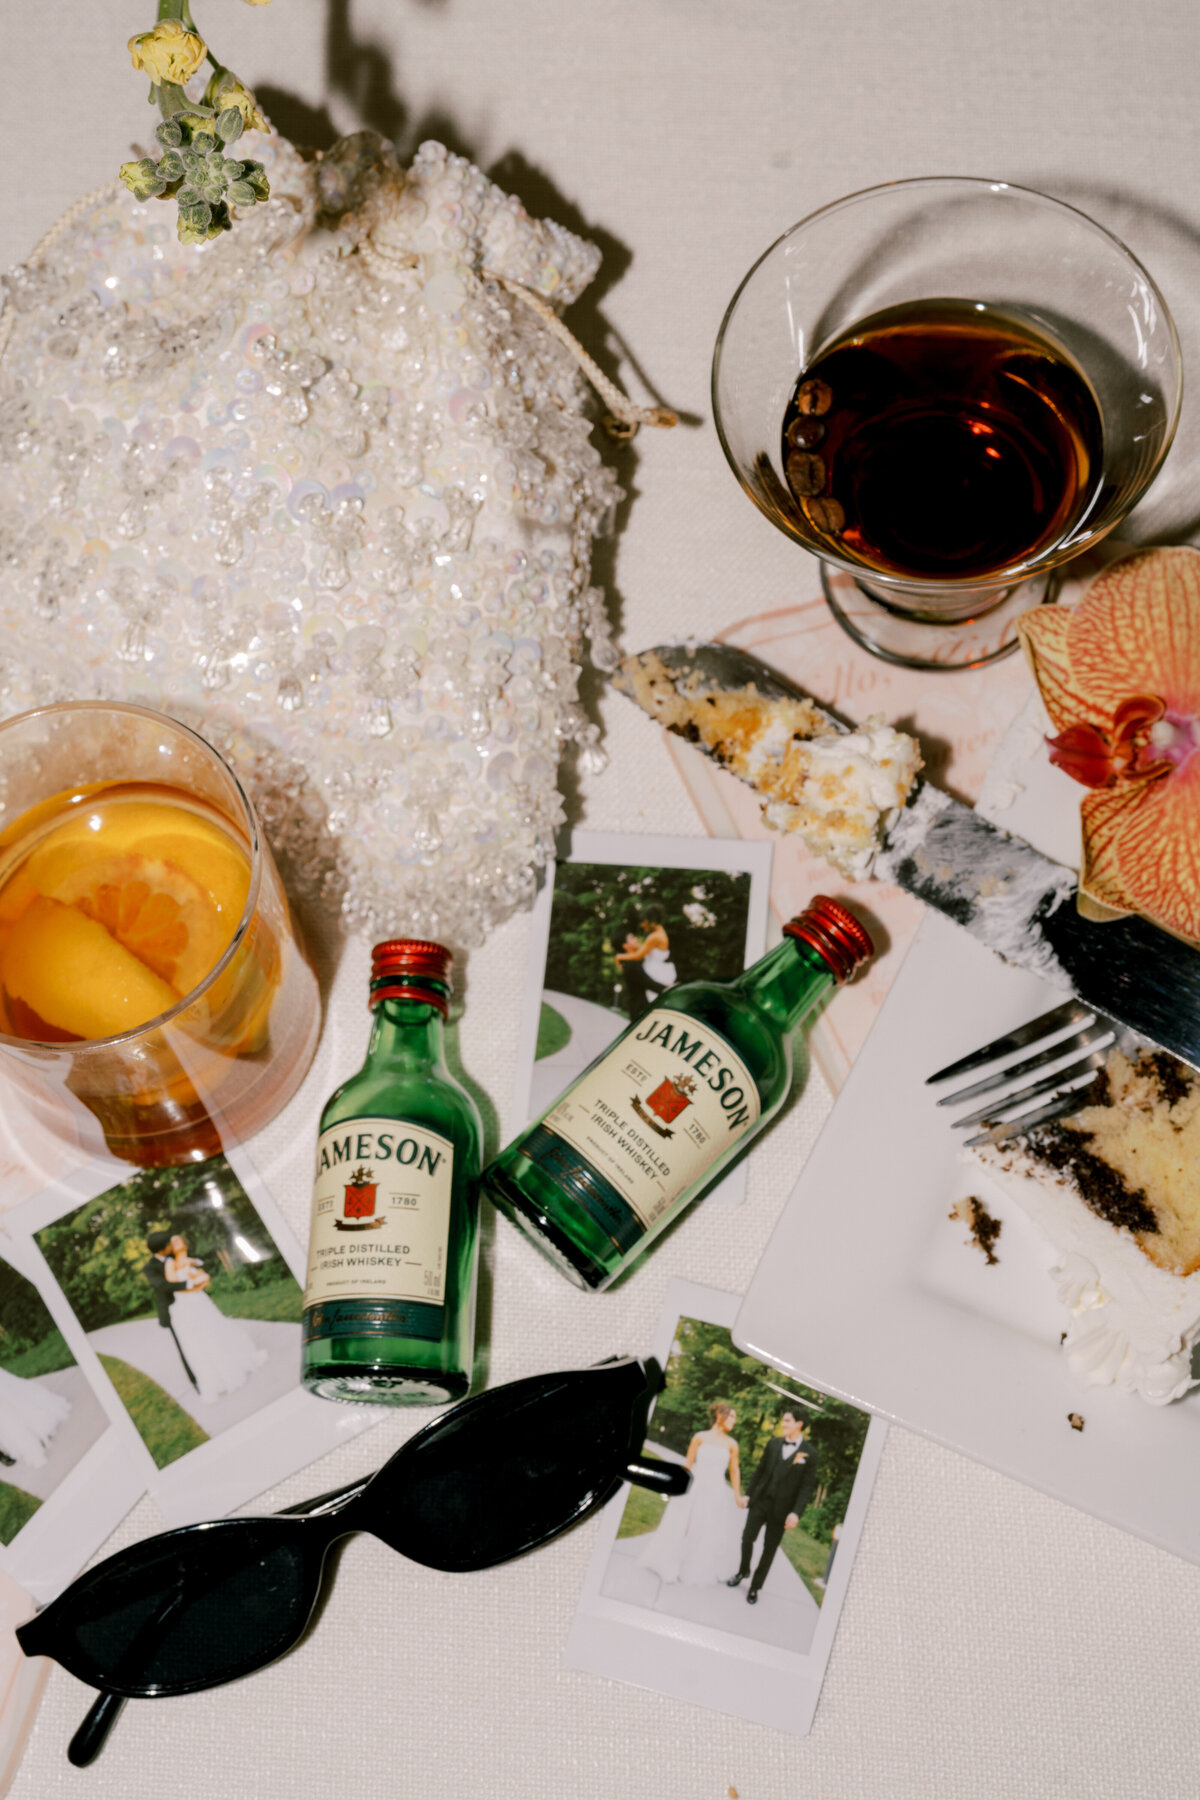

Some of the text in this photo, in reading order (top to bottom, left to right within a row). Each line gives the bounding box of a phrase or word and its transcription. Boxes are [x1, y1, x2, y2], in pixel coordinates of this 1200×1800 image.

[636, 1020, 750, 1131] JAMESON
[591, 1113, 618, 1139] IRISH
[617, 1136, 658, 1180] WHISKEY
[594, 1099, 628, 1130] TRIPLE
[627, 1128, 670, 1177] DISTILLED
[688, 1123, 706, 1144] 1780
[316, 1133, 442, 1177] AMESON
[391, 1196, 417, 1206] 1780
[317, 1243, 410, 1258] TRIPLE DISTILLED
[320, 1257, 402, 1270] IRISH WHISKEY
